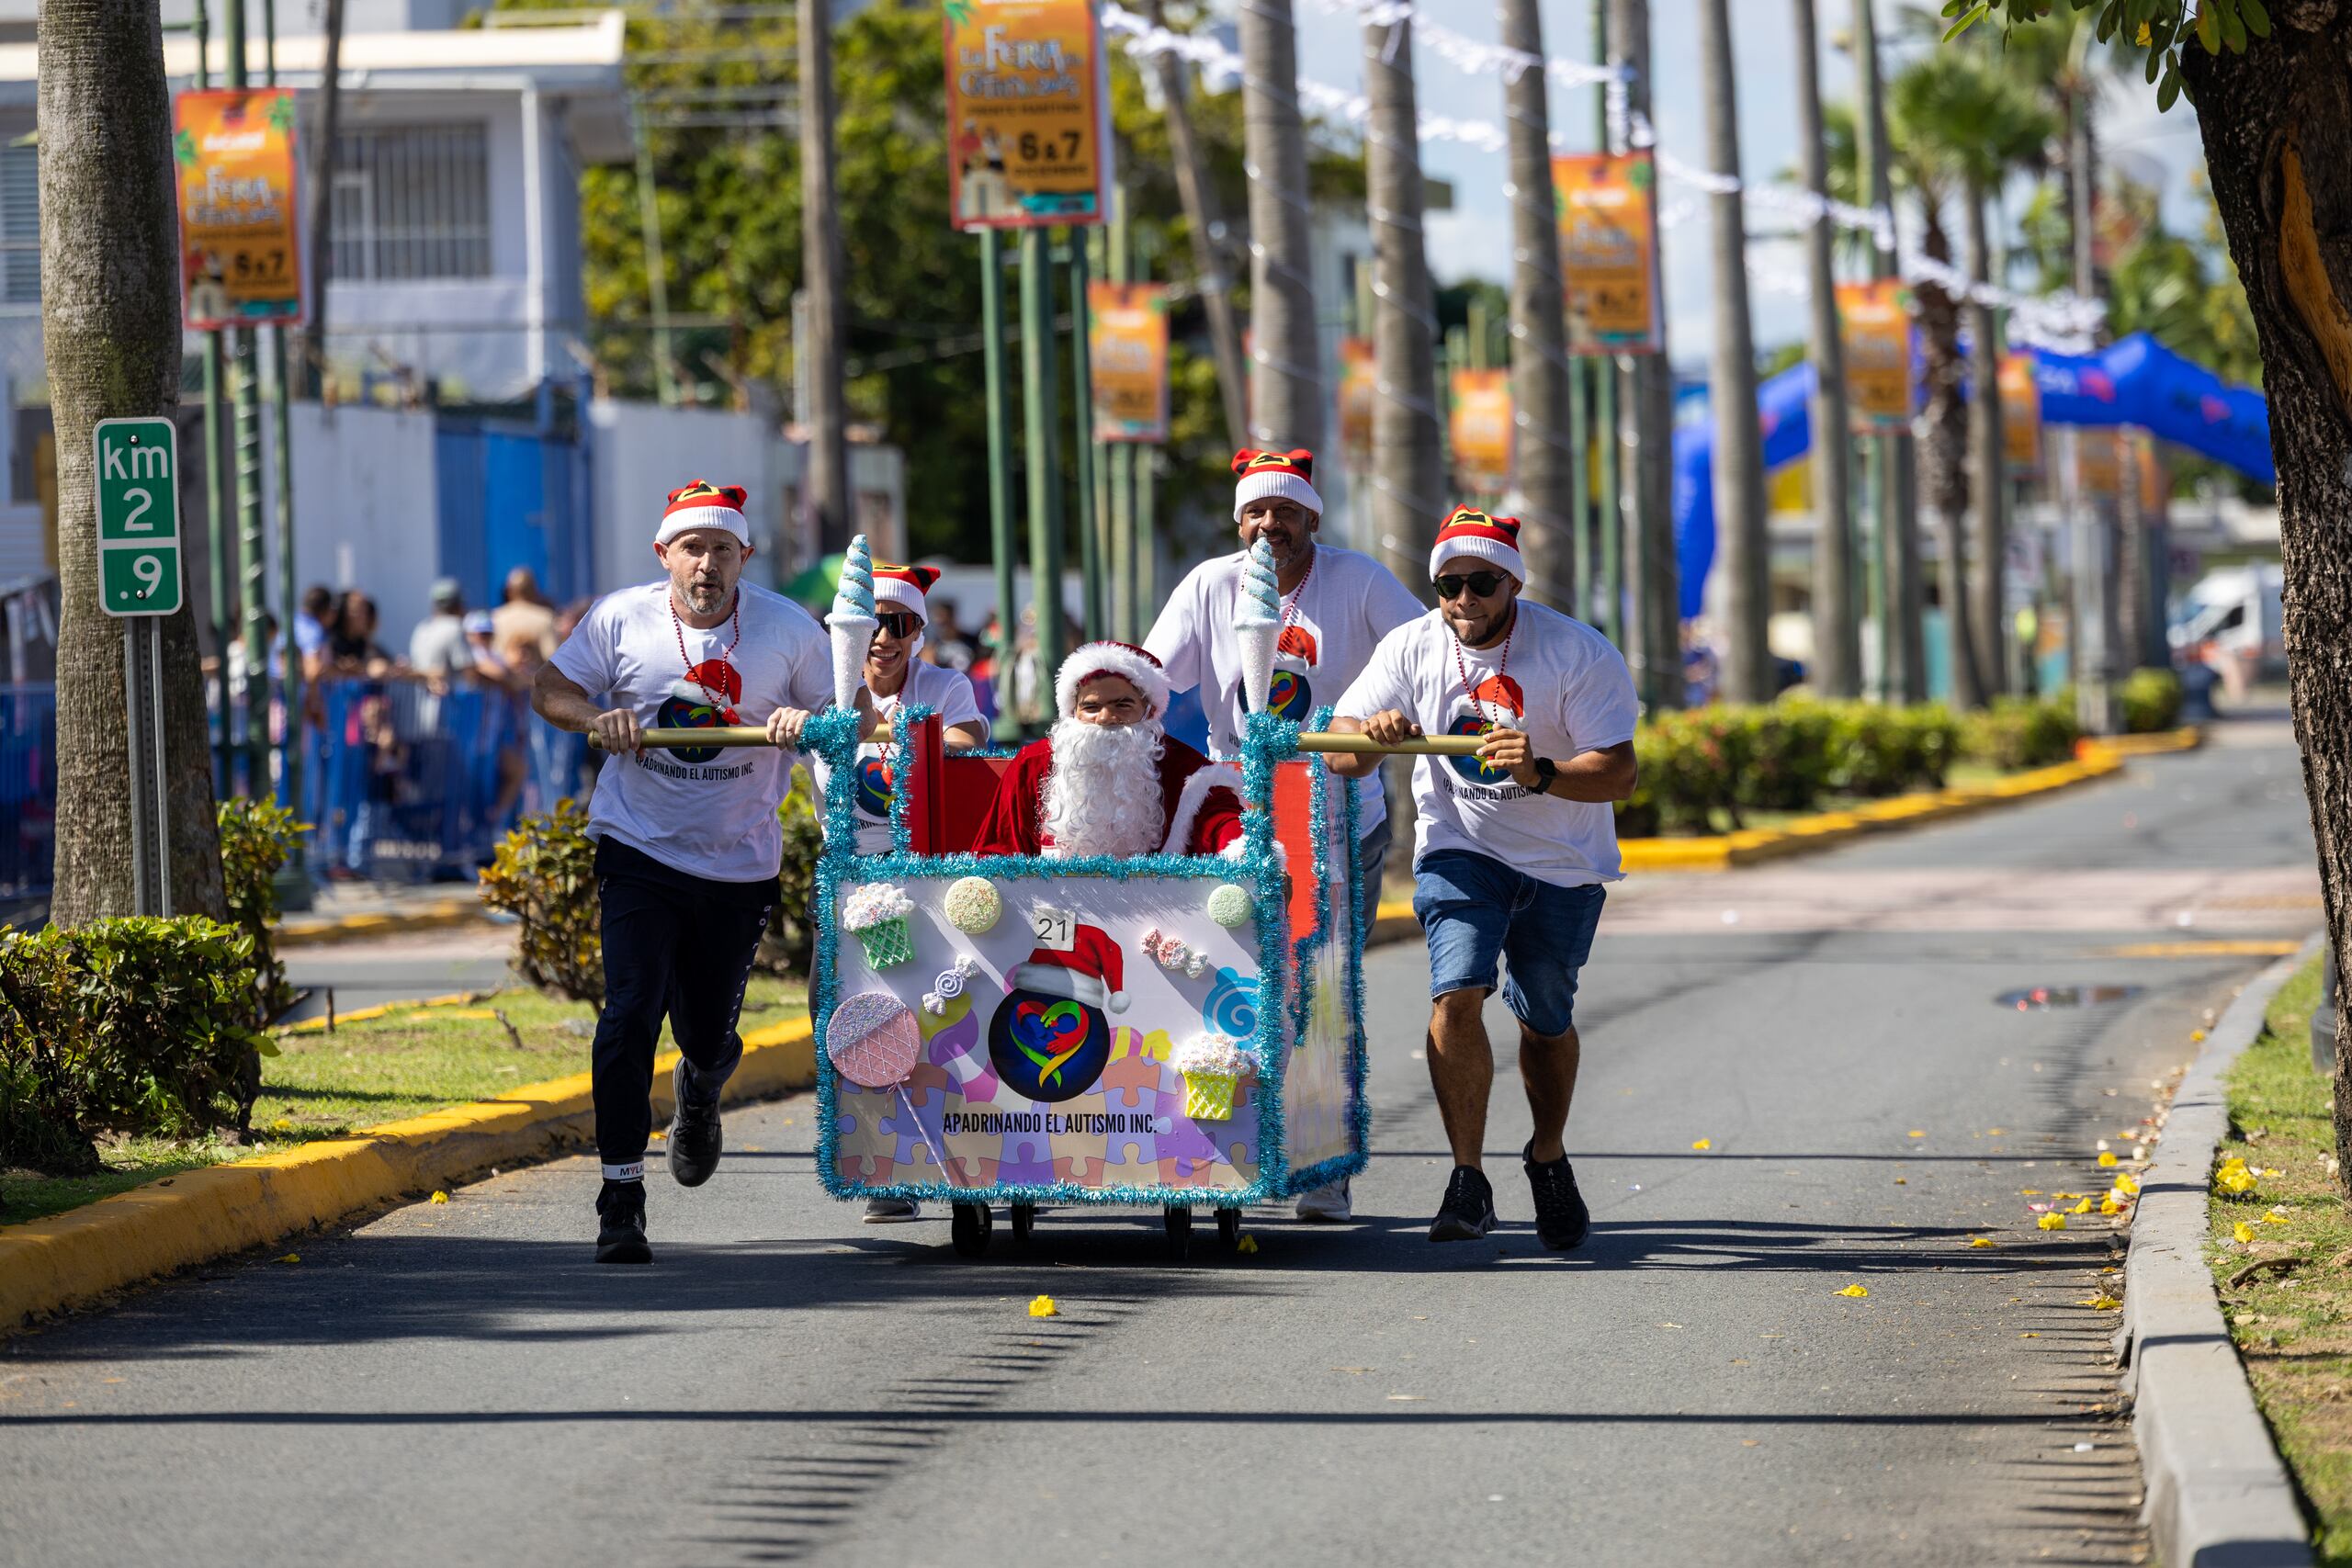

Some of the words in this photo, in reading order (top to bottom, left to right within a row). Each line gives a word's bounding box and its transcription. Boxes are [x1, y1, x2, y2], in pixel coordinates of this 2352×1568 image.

[1019, 132, 1039, 161] 6
[1062, 131, 1081, 160] 7
[103, 436, 168, 480] km
[123, 487, 153, 532] 2
[690, 768, 700, 781] EL
[702, 766, 740, 781] AUTISMO
[741, 761, 755, 776] INC.
[1443, 778, 1487, 800] PANANDO
[1489, 789, 1499, 800] EL
[1500, 785, 1533, 801] AUTIS
[1037, 918, 1066, 942] 21
[943, 1112, 1041, 1134] APADRINANDO
[1046, 1113, 1061, 1134] EL
[1065, 1113, 1125, 1134] AUTISMO
[1130, 1113, 1158, 1134] INC.
